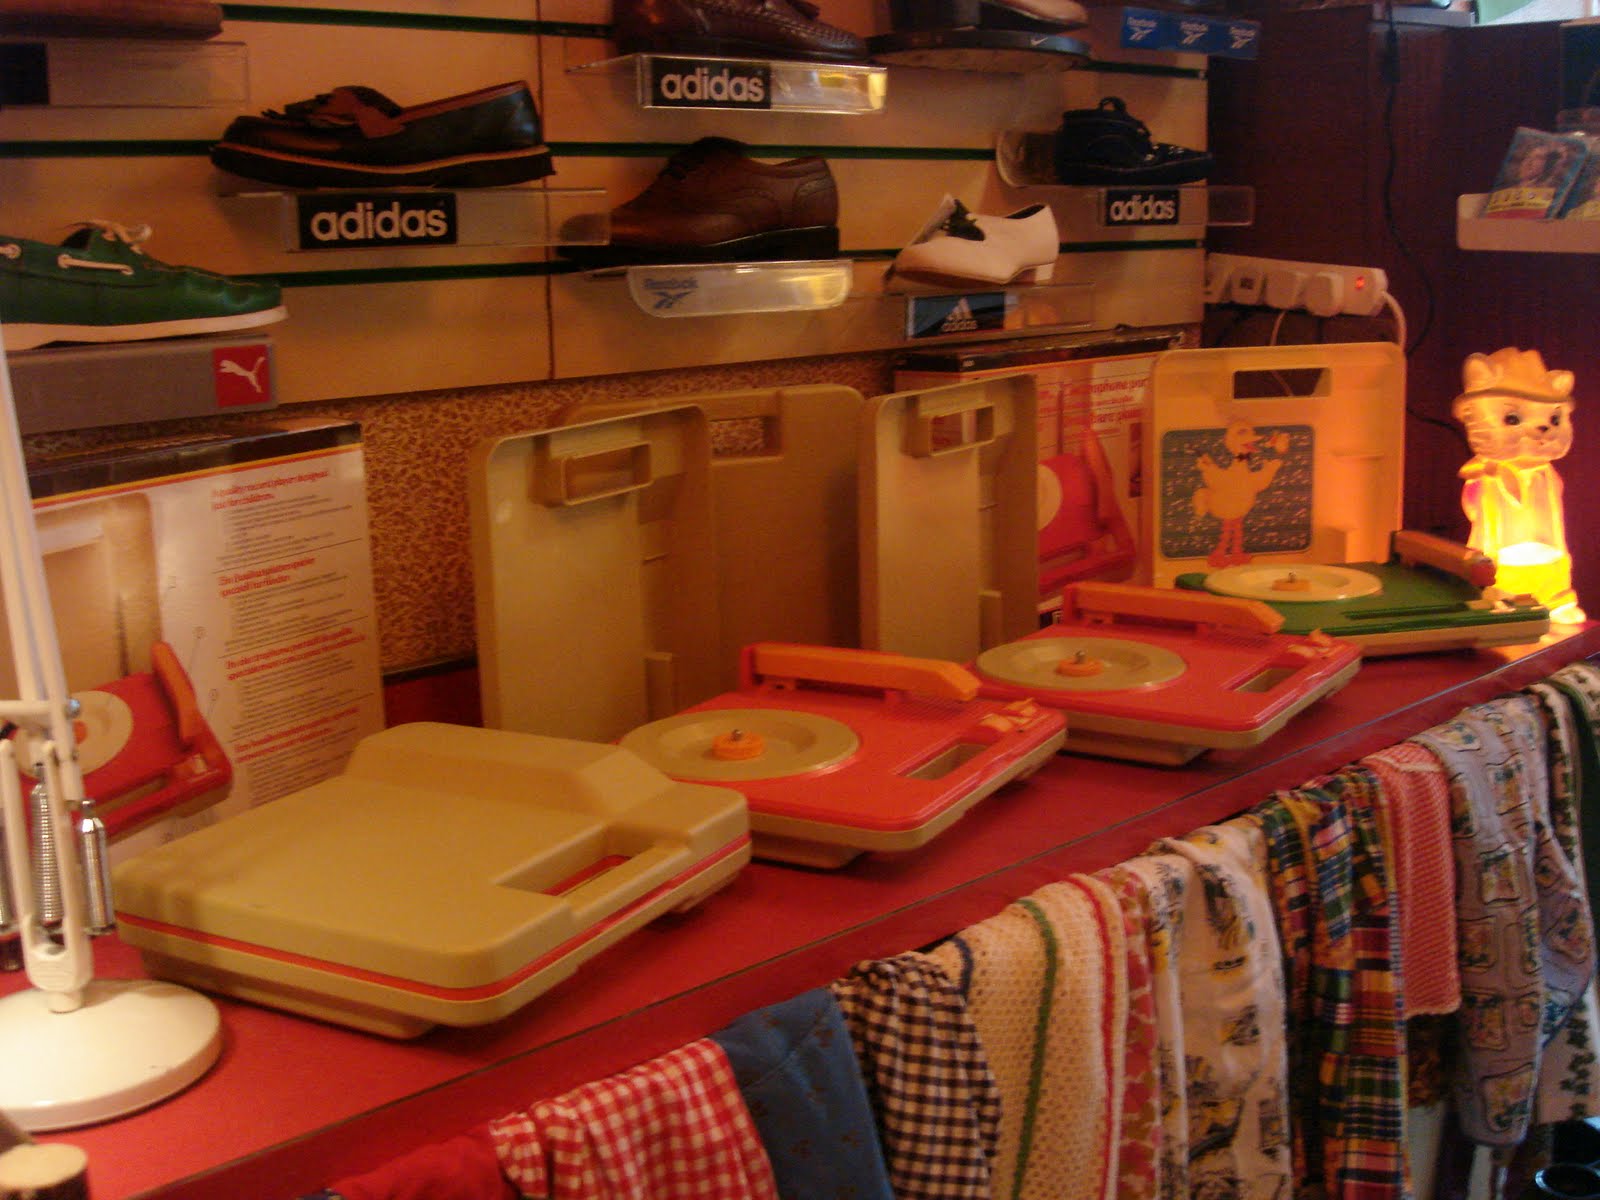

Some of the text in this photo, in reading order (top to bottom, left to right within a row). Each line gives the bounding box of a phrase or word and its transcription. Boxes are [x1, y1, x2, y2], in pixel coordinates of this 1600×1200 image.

[660, 68, 765, 103] adidas
[310, 200, 448, 242] adidas
[1109, 194, 1176, 221] adidas
[941, 320, 978, 332] adidas
